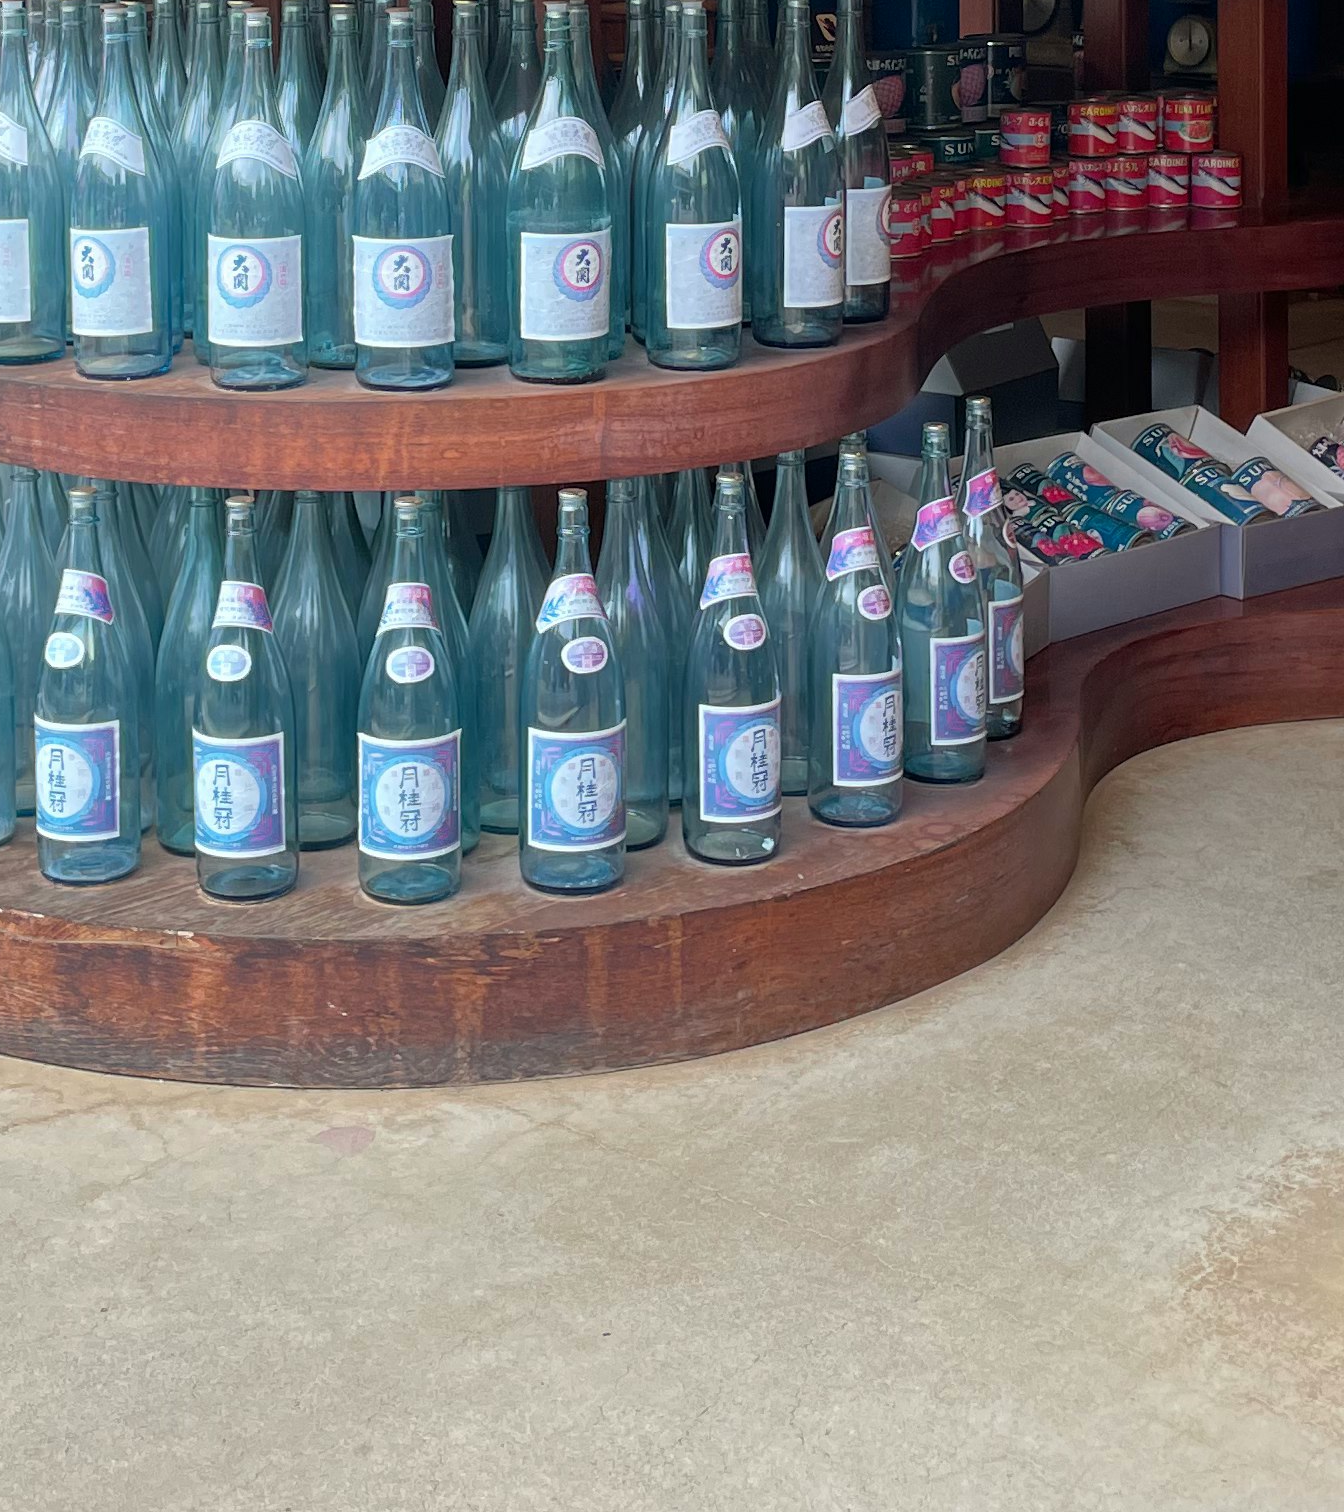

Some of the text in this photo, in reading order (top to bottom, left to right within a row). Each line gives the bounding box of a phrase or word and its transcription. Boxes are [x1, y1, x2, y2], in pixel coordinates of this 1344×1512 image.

[81, 246, 95, 282] 大関
[233, 254, 250, 291] 大関
[393, 254, 410, 291] 大関
[576, 248, 592, 285] 大関
[720, 236, 733, 273] 大関
[47, 747, 68, 812] 月桂冠
[751, 728, 769, 793] 月桂冠
[212, 764, 234, 831] 月桂冠
[398, 767, 422, 834] 月桂冠
[576, 757, 598, 824] 月桂冠
